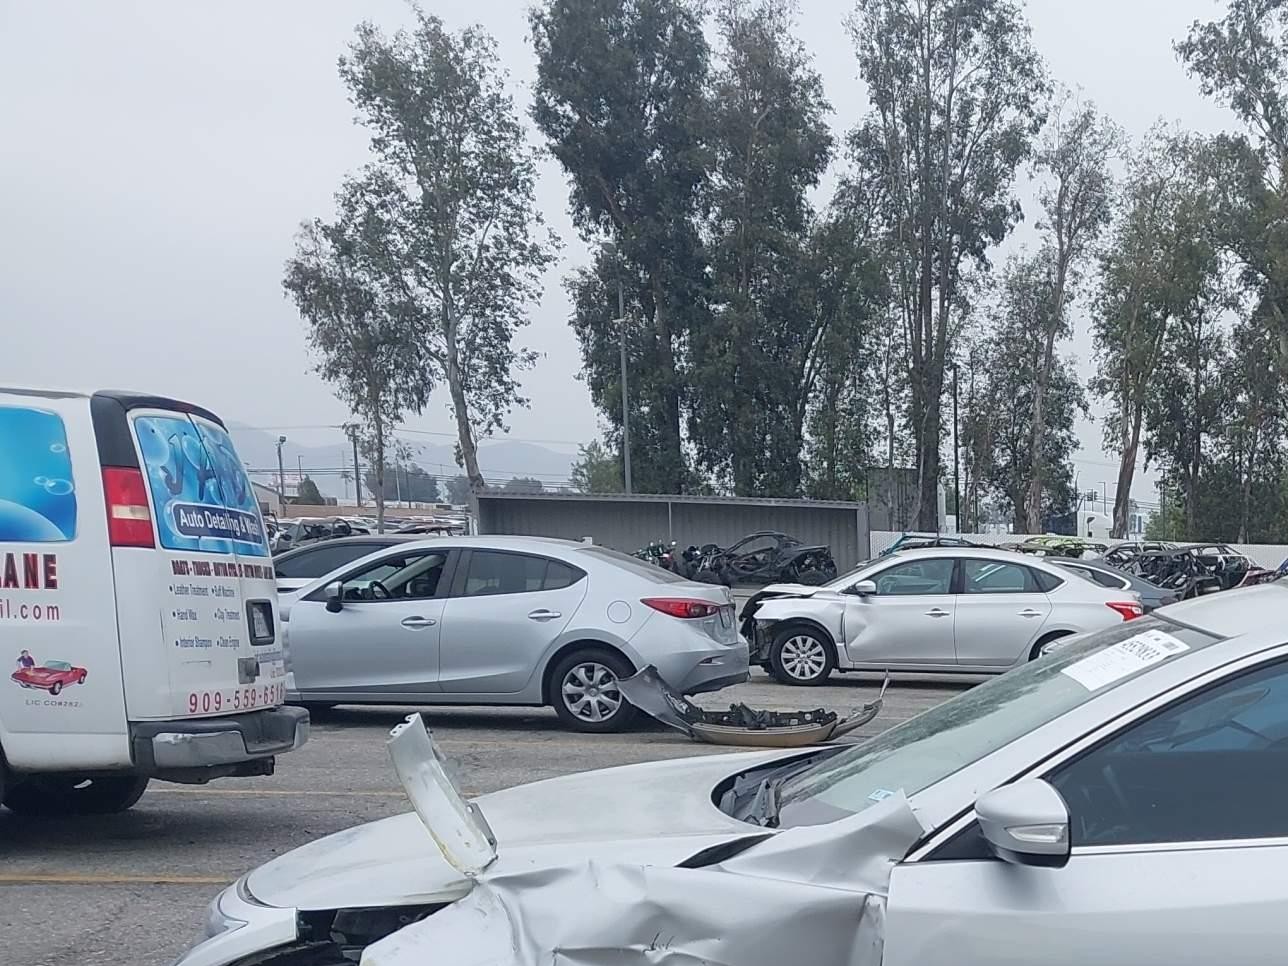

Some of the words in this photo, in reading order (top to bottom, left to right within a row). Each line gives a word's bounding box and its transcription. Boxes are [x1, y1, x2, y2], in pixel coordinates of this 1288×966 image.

[180, 509, 204, 528] Auto
[204, 511, 240, 536] Detailing
[239, 516, 246, 533] &
[0, 552, 58, 590] ANE
